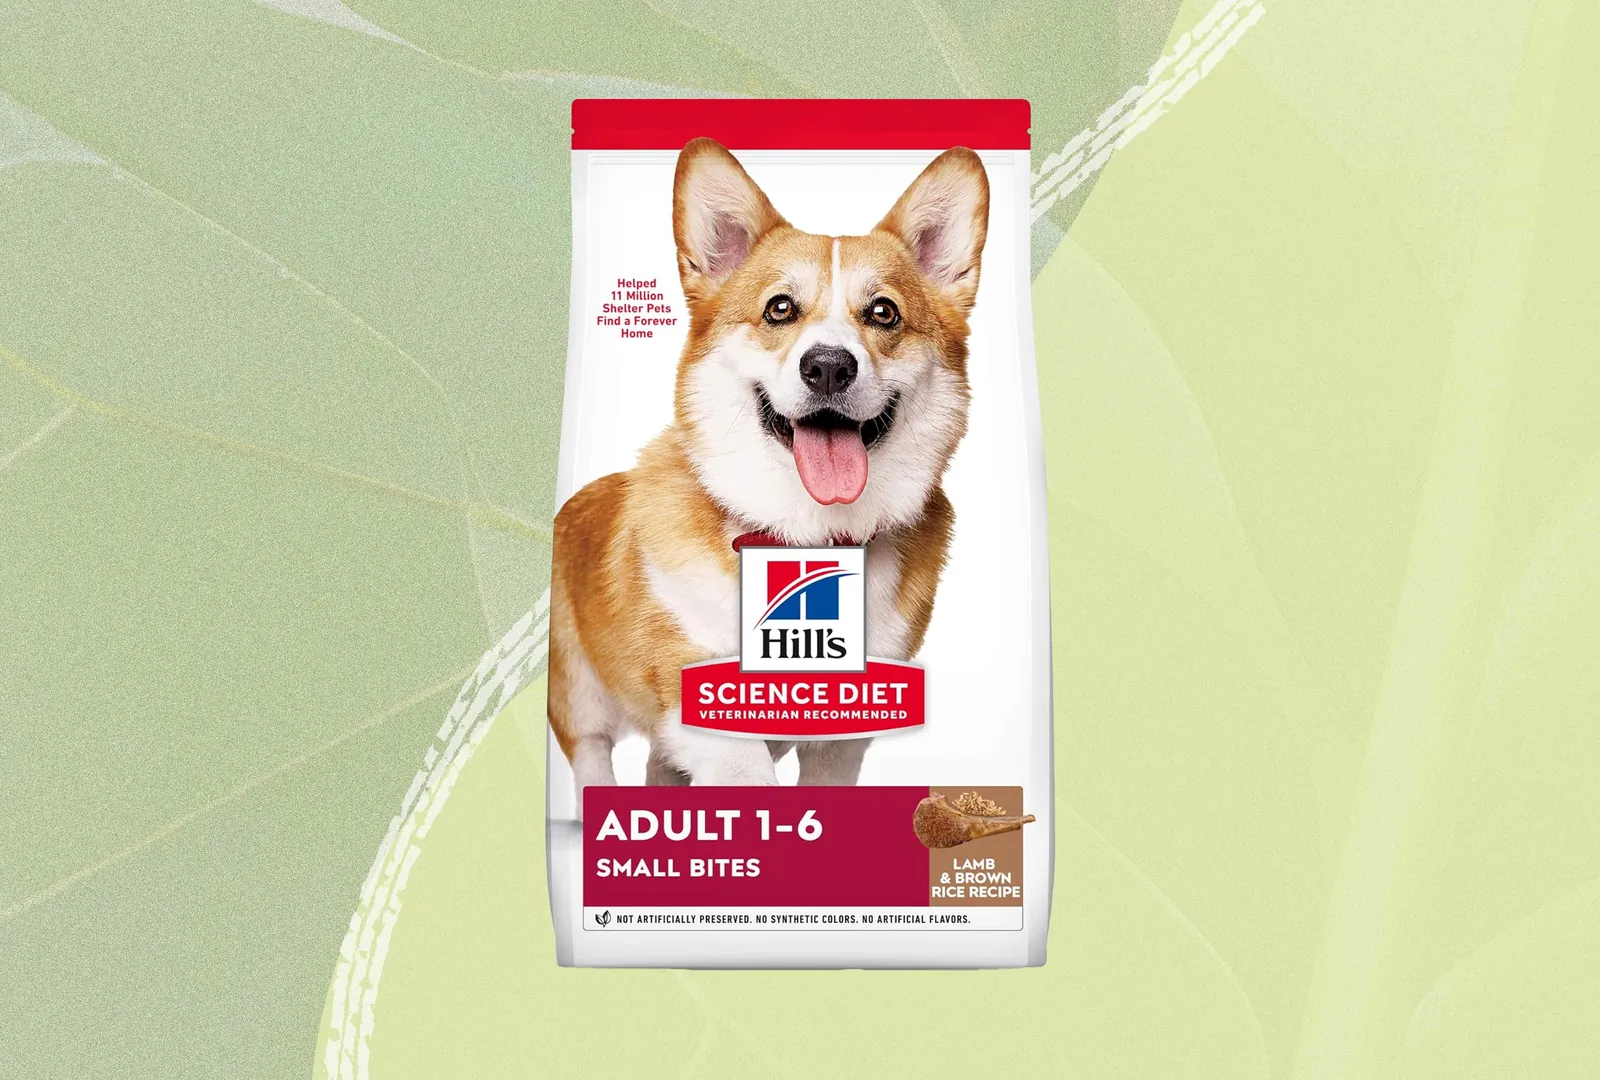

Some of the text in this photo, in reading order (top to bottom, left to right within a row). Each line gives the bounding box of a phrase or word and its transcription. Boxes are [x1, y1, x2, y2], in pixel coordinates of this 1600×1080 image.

[617, 278, 657, 291] Helped
[611, 290, 664, 301] 11 Million
[602, 303, 672, 314] Shelter Pets
[596, 315, 678, 326] Find a Forever
[621, 328, 653, 339] Home
[760, 627, 847, 660] Hill's
[698, 682, 909, 705] SCIENCE DIET
[699, 709, 908, 720] VETERINARIAN RECOMMENDED
[595, 809, 823, 842] ADULT 1-6
[596, 858, 761, 878] SMALL BITES
[953, 858, 996, 870] LAMB
[939, 871, 1012, 885] & BROWN
[931, 885, 1020, 898] RICE RECIPE
[616, 914, 971, 924] NOT ARTIFICIALLY PRESERVED. NO SYNTHETIC COLORS. NO ARTIFICIAL FLAVORS.
